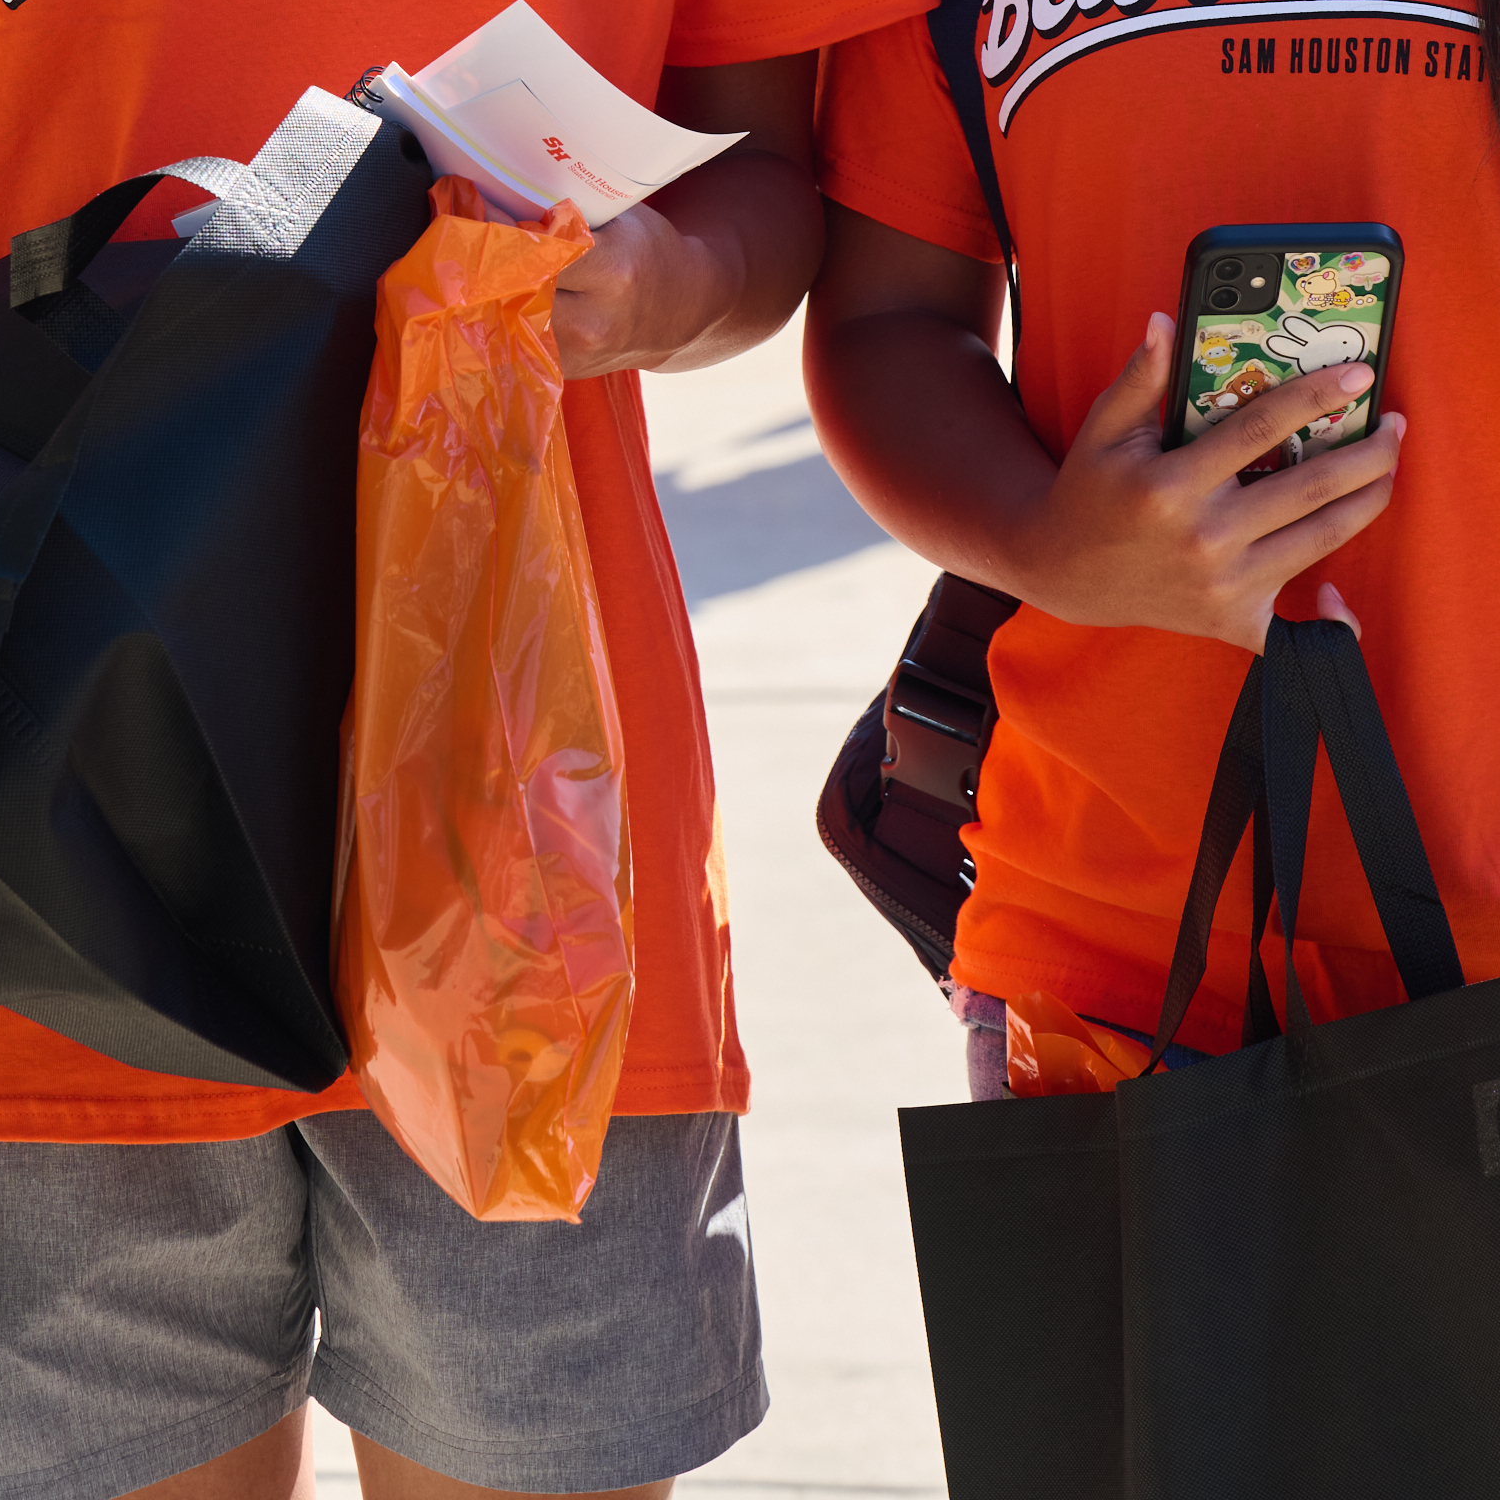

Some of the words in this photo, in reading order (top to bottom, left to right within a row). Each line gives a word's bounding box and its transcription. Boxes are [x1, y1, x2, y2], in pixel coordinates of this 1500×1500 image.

[1221, 37, 1276, 74] SAM
[1289, 36, 1411, 75] HOUSTON
[1424, 40, 1486, 83] STAT
[542, 136, 572, 162] SH
[567, 165, 586, 181] State
[584, 179, 618, 201] University
[574, 161, 596, 180] Sam
[595, 178, 633, 200] Houston
